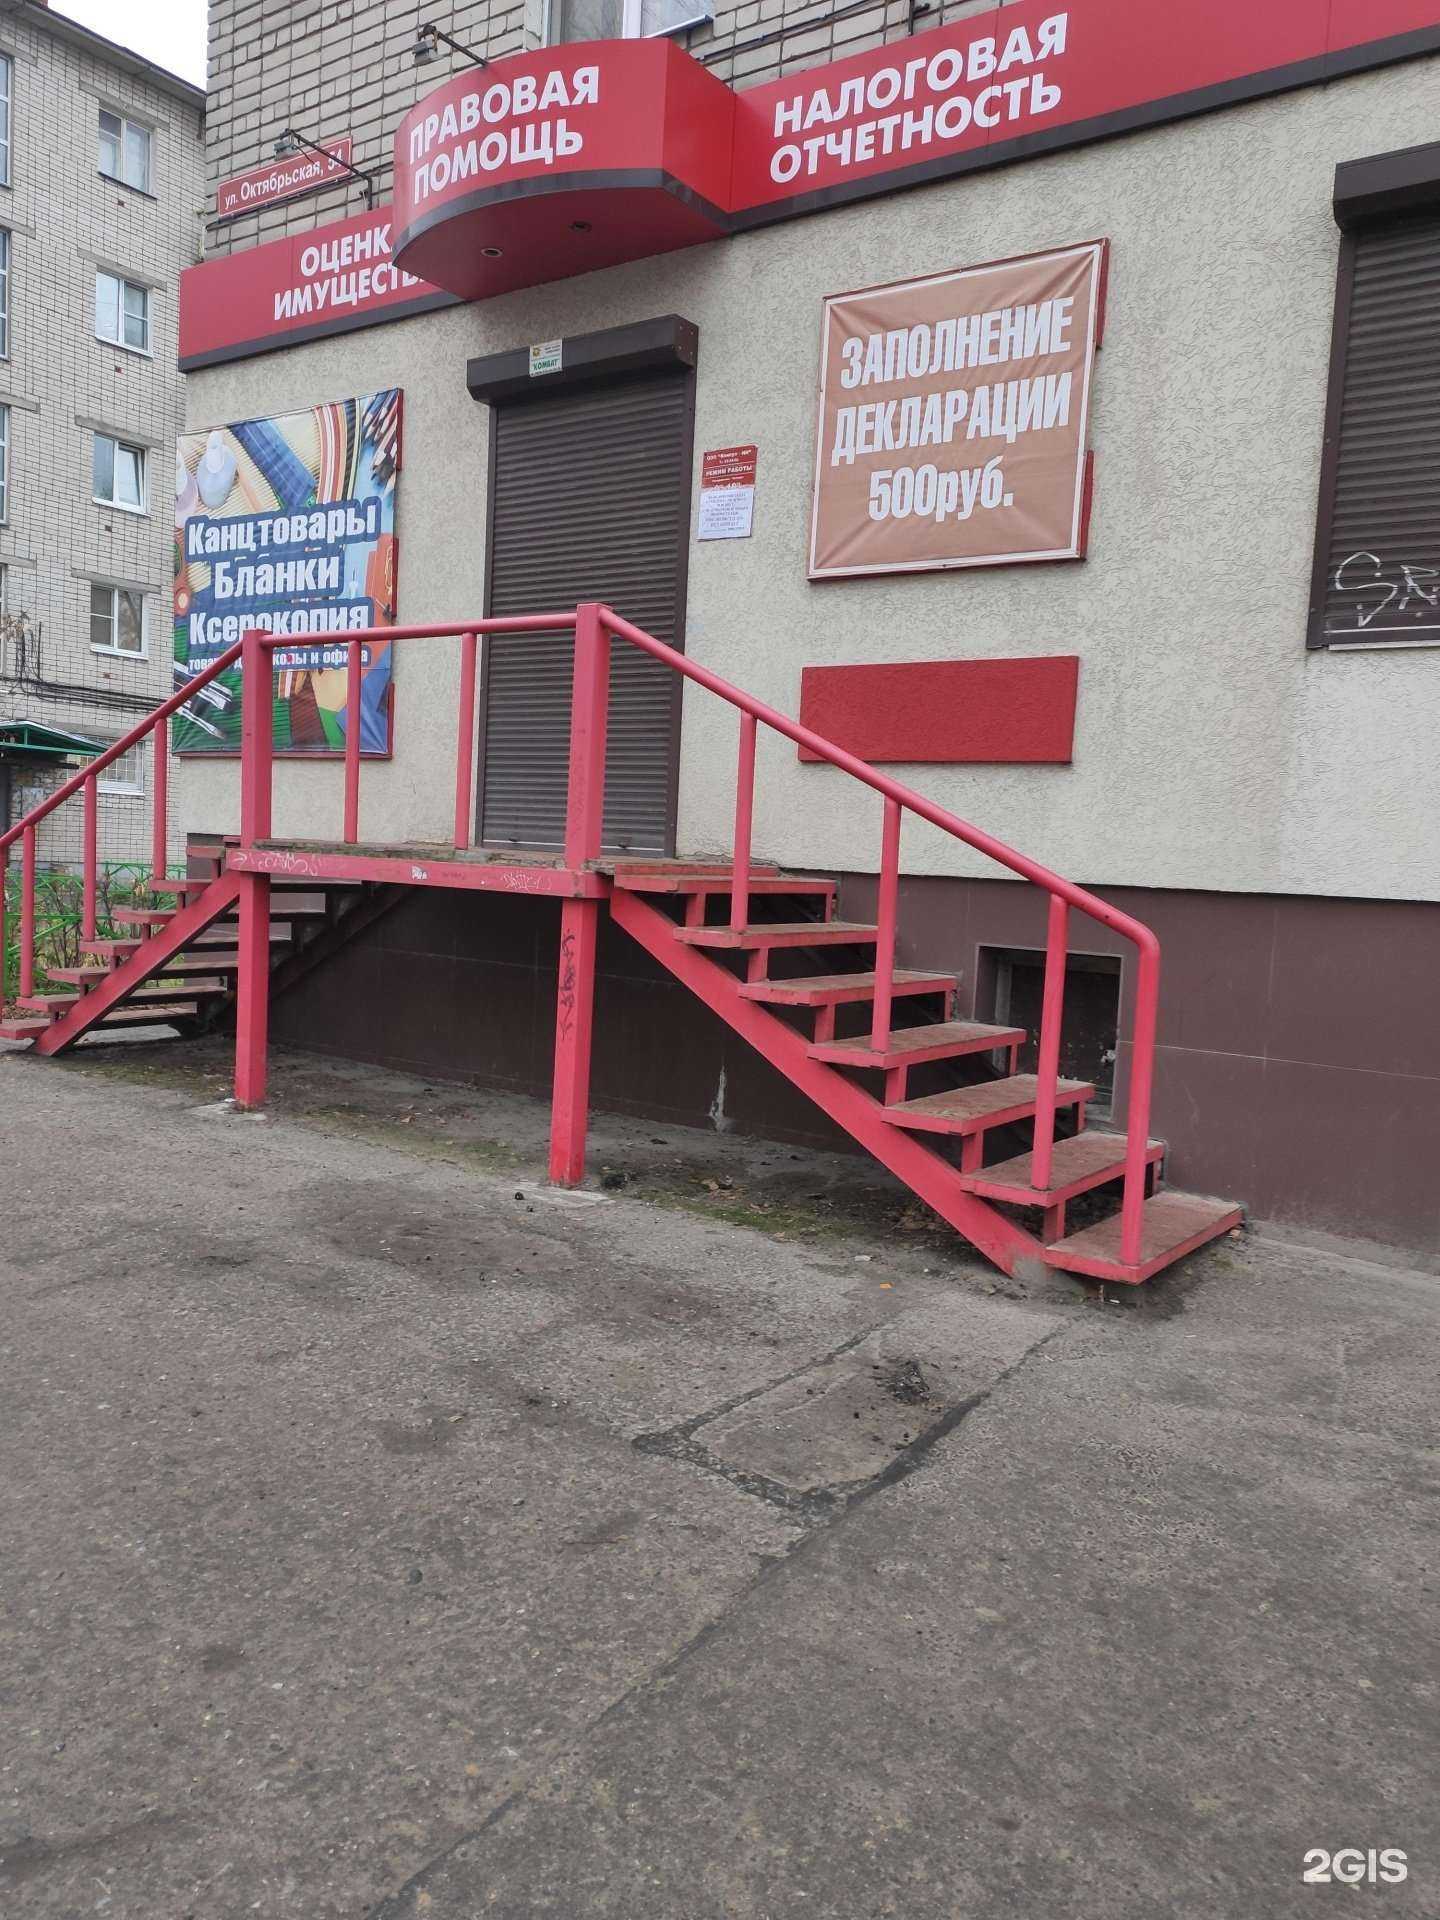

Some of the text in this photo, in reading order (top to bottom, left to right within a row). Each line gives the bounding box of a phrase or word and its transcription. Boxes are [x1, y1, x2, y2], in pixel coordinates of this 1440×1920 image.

[773, 13, 1068, 138] НАЛОГОВАЯ
[410, 66, 599, 165] ПРАВОВАЯ
[769, 73, 1061, 184] ОТЧЕТНОСТЬ
[225, 194, 238, 210] ул.
[240, 160, 324, 201] Октябрьская,
[414, 118, 583, 205] ПОМОЩЬ
[300, 223, 392, 277] ОЦЕНК
[840, 296, 1074, 389] ЗАПОЛНЕНИЕ
[831, 371, 1073, 467] ДЕКЛАРАЦИИ
[868, 455, 1014, 522] 500руб.
[188, 505, 376, 555] Канцтовары
[214, 557, 340, 599] Бланки
[272, 653, 306, 666] колы
